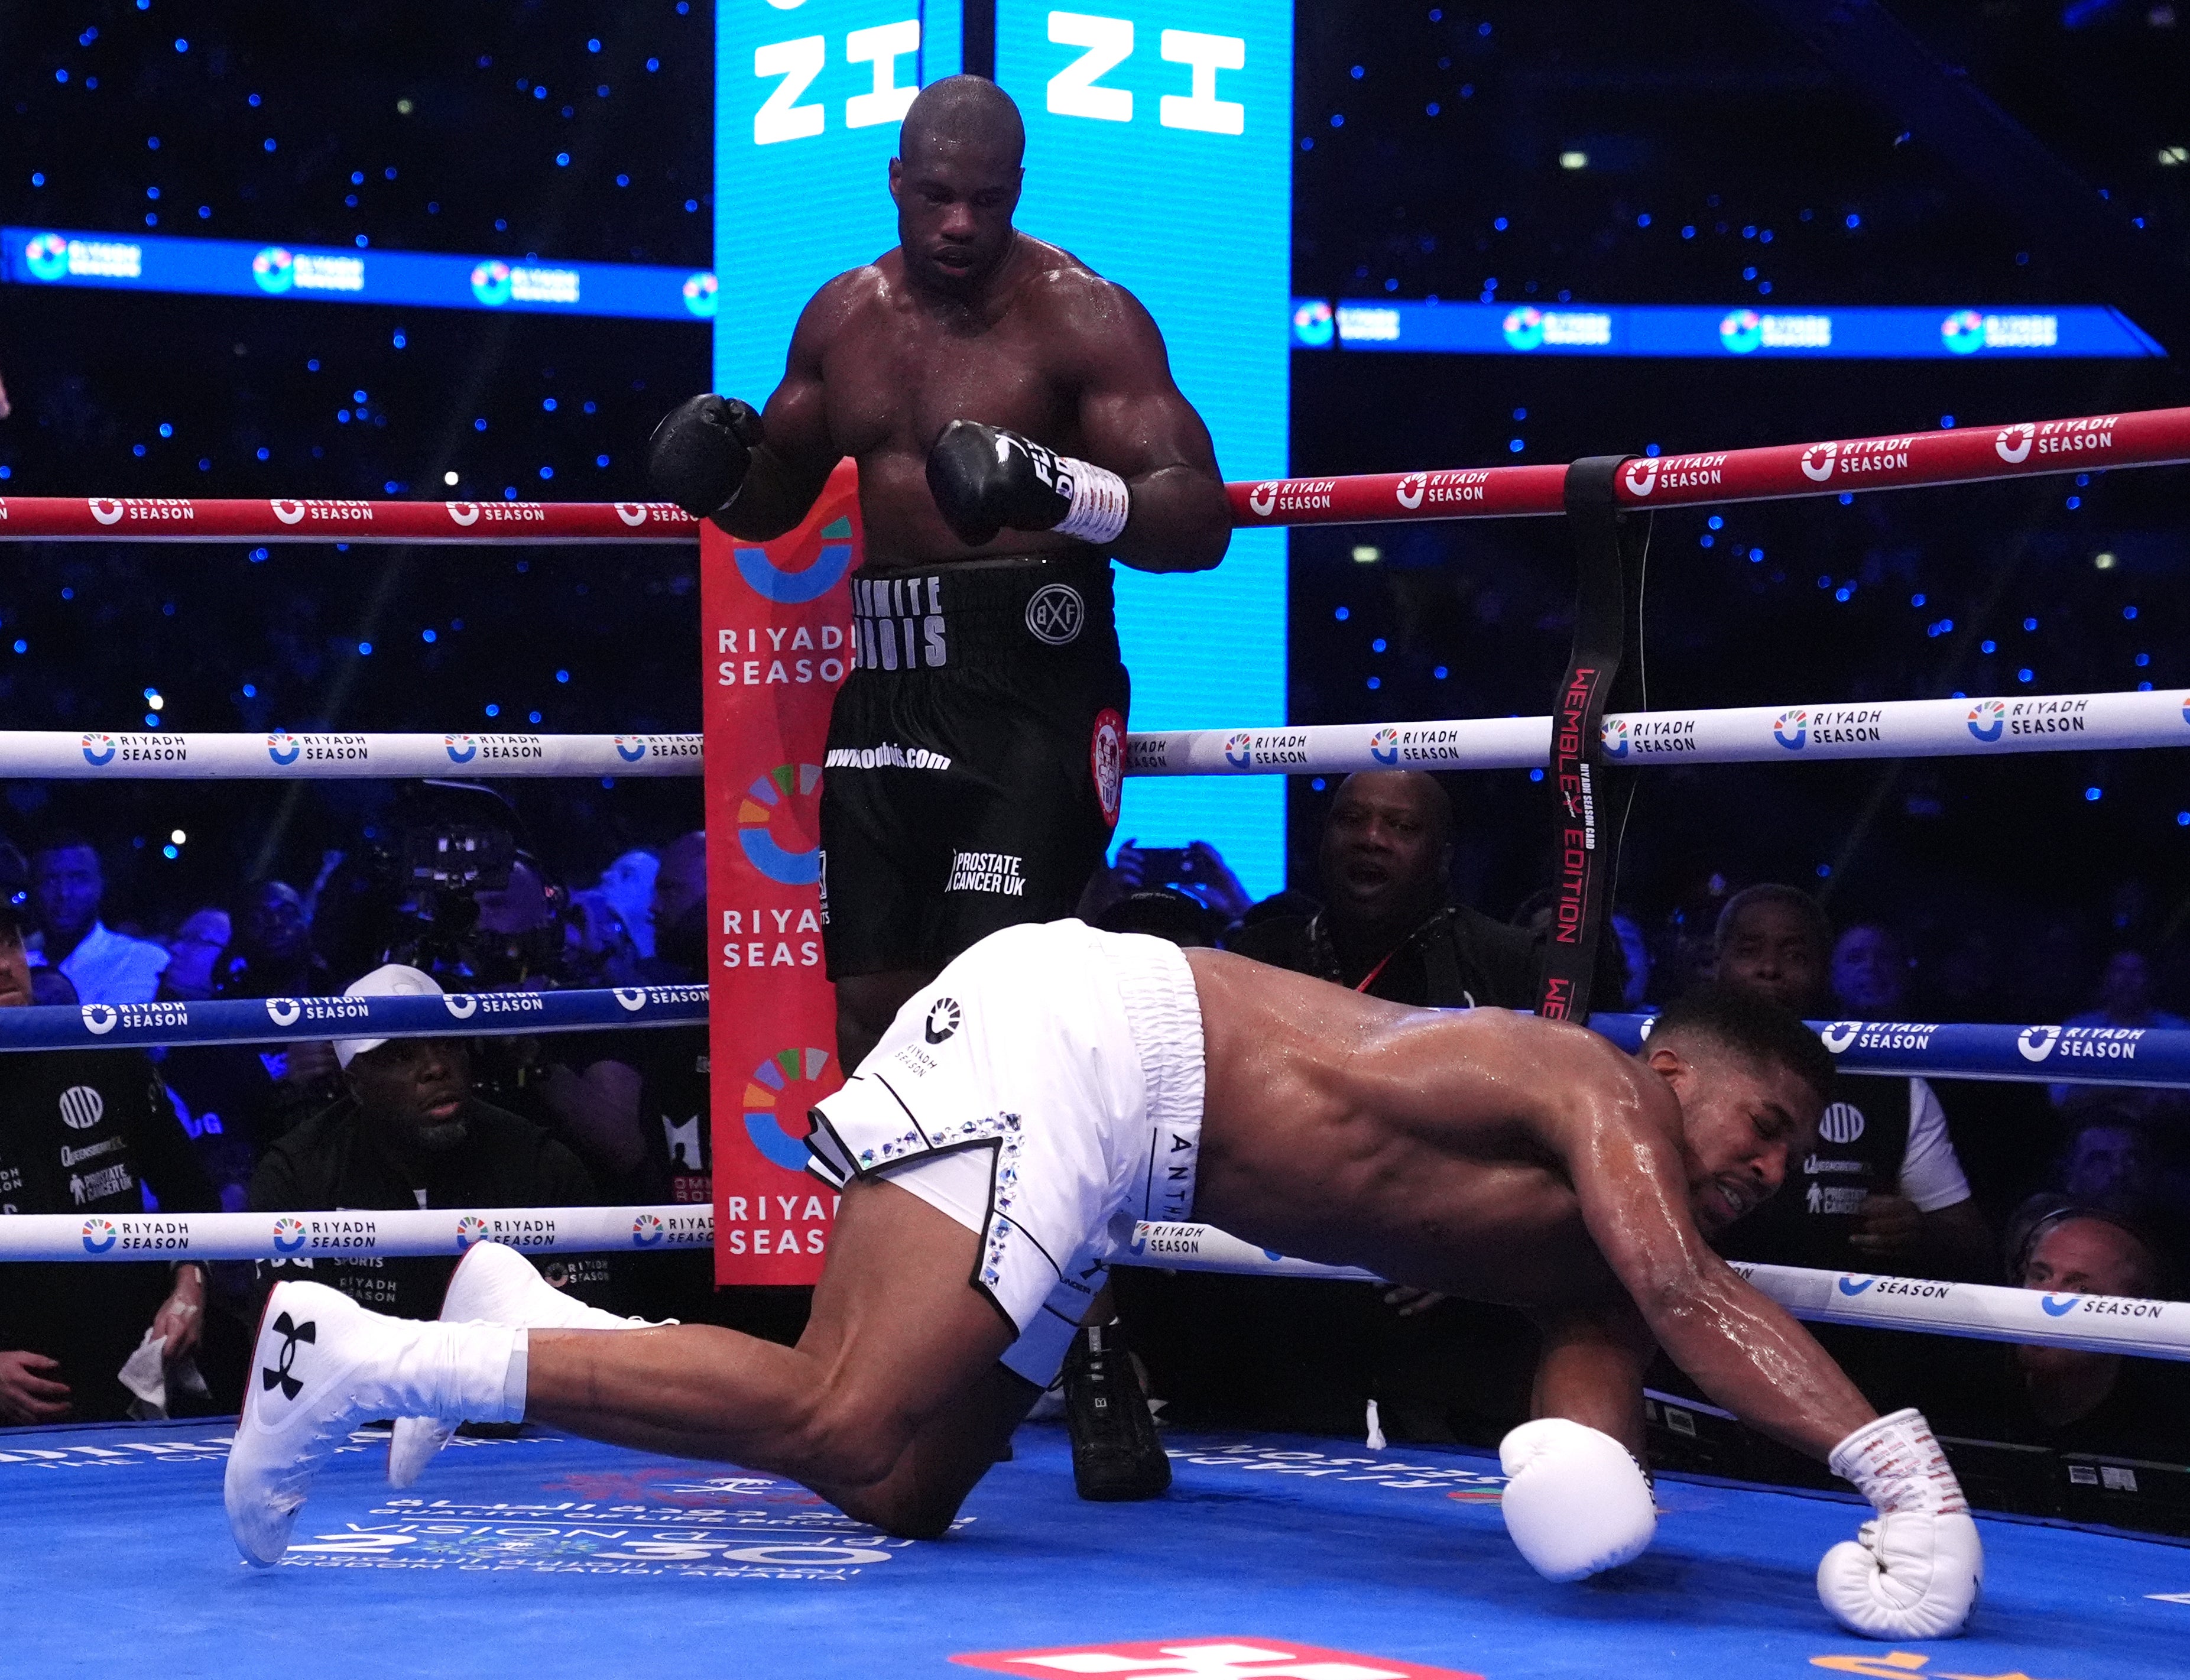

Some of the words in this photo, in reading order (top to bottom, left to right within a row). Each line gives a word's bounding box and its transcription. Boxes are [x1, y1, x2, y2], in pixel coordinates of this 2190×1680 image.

[2040, 417, 2118, 434] RIYADH
[1842, 436, 1914, 455] RIYADH
[2039, 433, 2111, 453] SEASON
[1663, 455, 1727, 471] RIYADH
[1841, 453, 1907, 473] SEASON
[1431, 472, 1488, 486] RIYADH
[1661, 470, 1721, 488] SEASON
[1281, 481, 1335, 494] RIYADH
[1429, 487, 1484, 502] SEASON
[1280, 495, 1331, 509] SEASON
[130, 508, 193, 519] SEASON
[312, 509, 373, 520] SEASON
[485, 510, 544, 521] SEASON
[719, 657, 856, 686] SEASO
[2013, 700, 2088, 715] RIYADH
[1814, 711, 1882, 725] RIYADH
[1634, 721, 1695, 737] RIYADH
[2011, 716, 2085, 735] SEASON
[121, 736, 185, 746] RIYADH
[303, 736, 366, 745] RIYADH
[479, 736, 540, 744] RIYADH
[1255, 735, 1307, 749] RIYADH
[1403, 730, 1457, 745] RIYADH
[1559, 669, 1595, 813] WEMBLEY
[1813, 727, 1880, 744] SEASON
[483, 746, 542, 758] SEASON
[1634, 738, 1696, 753] SEASON
[122, 748, 186, 761] SEASON
[306, 748, 368, 760] SEASON
[1255, 750, 1307, 764] SEASON
[1403, 746, 1459, 760] SEASON
[1580, 764, 1592, 793] RIYADH
[1583, 795, 1595, 826] SEASON
[1585, 827, 1595, 849] CARD
[956, 852, 1021, 876] PROSTATE
[953, 872, 1002, 893] CANCER
[1004, 877, 1026, 897] UK
[1556, 829, 1585, 943] EDITION
[723, 909, 820, 935] RIYA
[723, 942, 819, 968] SEAS
[651, 991, 709, 1004] SEASON
[120, 1003, 186, 1013] RIYADH
[482, 998, 543, 1012] SEASON
[307, 1006, 368, 1019] SEASON
[124, 1013, 187, 1027] SEASON
[1866, 1023, 1939, 1033] RIYADH
[2066, 1027, 2144, 1040] RIYADH
[1860, 1034, 1929, 1050] SEASON
[906, 1044, 937, 1069] RIYADH
[2060, 1041, 2136, 1059] SEASON
[895, 1052, 926, 1078] SEASON
[729, 1196, 842, 1221] RIYA
[123, 1223, 188, 1234] RIYADH
[312, 1222, 375, 1233] RIYADH
[494, 1221, 554, 1232] RIYADH
[1153, 1227, 1205, 1237] RIYADH
[122, 1237, 189, 1249] SEASON
[312, 1236, 375, 1248] SEASON
[730, 1230, 825, 1254] SEAS
[1151, 1240, 1199, 1253] SEASON
[1877, 1281, 1950, 1299] SEASON
[2084, 1300, 2164, 1319] SEASON
[369, 1509, 553, 1517] QUALITY
[346, 1523, 628, 1538] VISION
[533, 1567, 663, 1575] SAUDI
[680, 1571, 847, 1581] ARABIA
